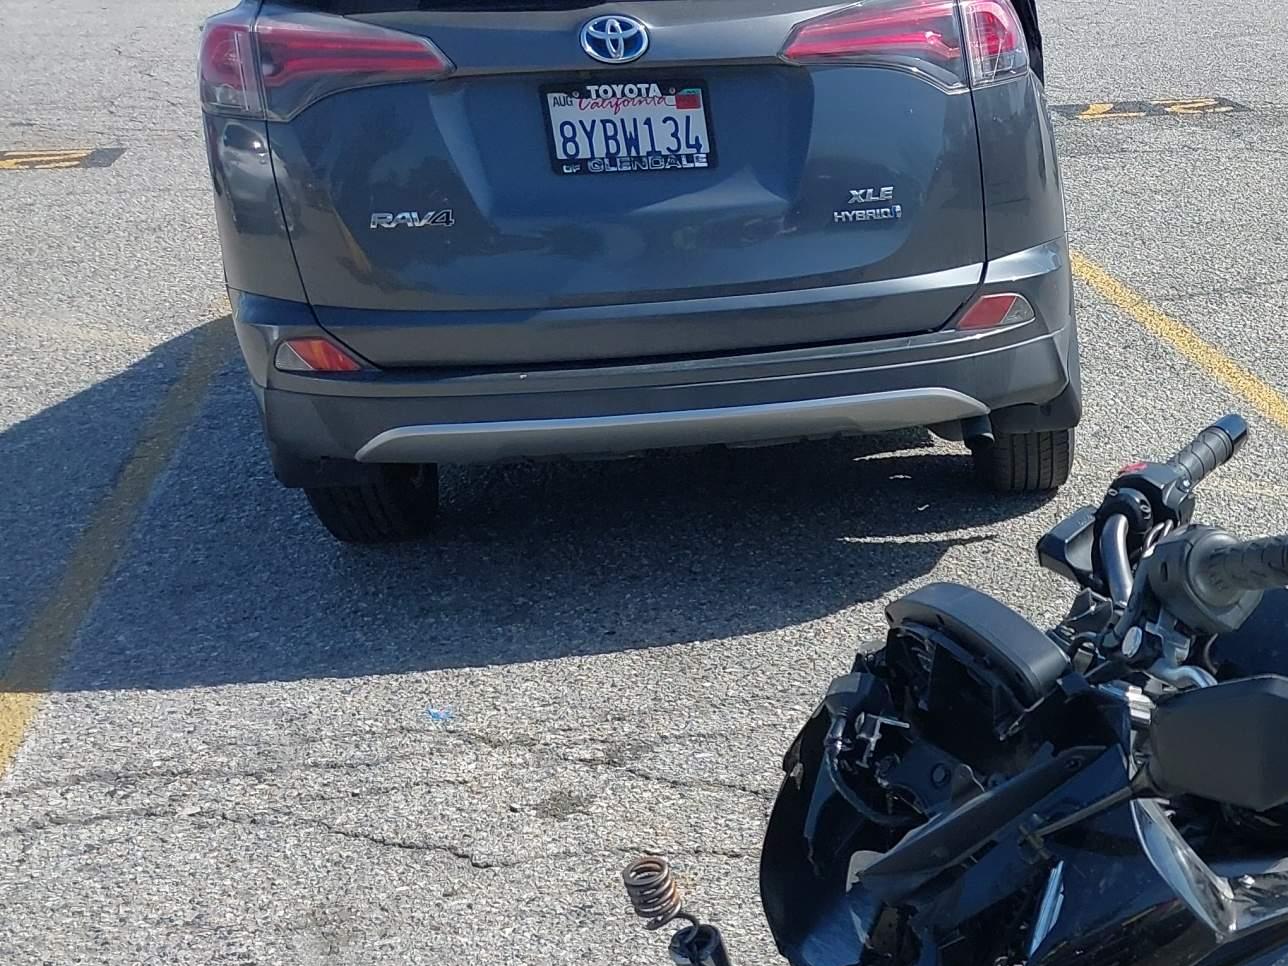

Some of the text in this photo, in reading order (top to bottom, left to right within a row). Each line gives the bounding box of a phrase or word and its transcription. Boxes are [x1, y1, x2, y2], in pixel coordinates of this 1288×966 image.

[586, 83, 663, 99] TOYOTA
[552, 95, 574, 107] AUG
[578, 95, 676, 115] California
[559, 115, 703, 159] 8YBW134
[587, 153, 709, 173] GLENDALE
[847, 186, 894, 204] XLE
[369, 209, 455, 229] RAV4
[833, 207, 892, 222] HYBRID
